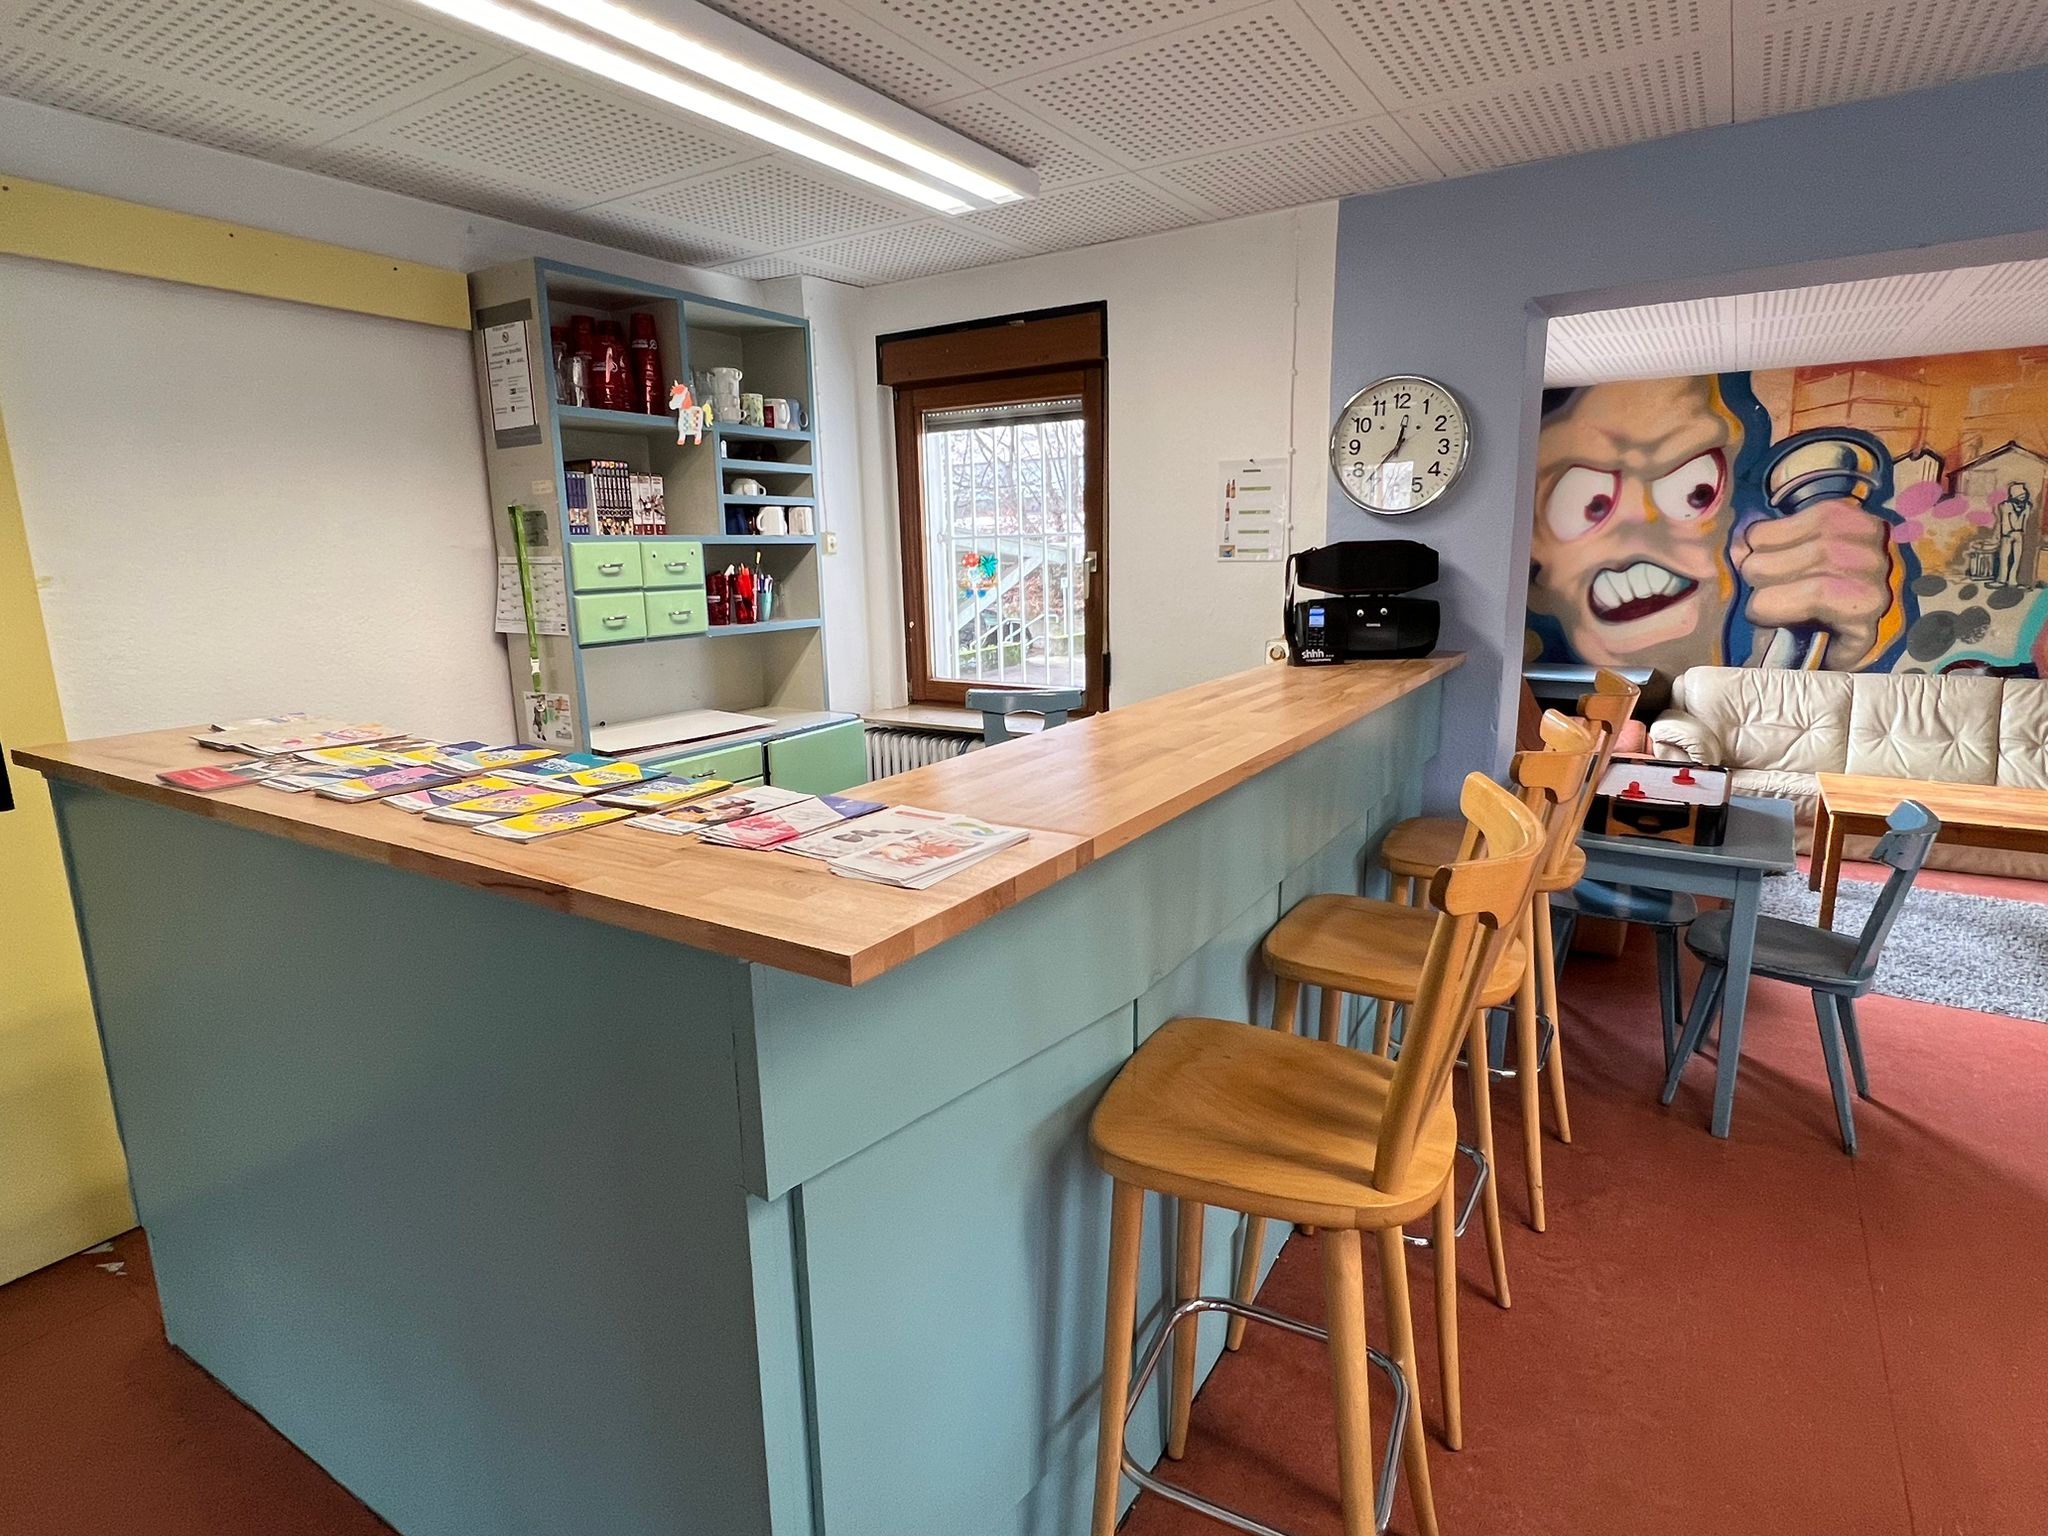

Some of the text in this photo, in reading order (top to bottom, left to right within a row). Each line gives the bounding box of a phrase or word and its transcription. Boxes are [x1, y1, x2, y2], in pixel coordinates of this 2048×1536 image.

[1373, 400, 1387, 416] 11
[1393, 393, 1412, 409] 12
[1423, 398, 1430, 414] 1
[1354, 417, 1372, 433] 10
[1434, 415, 1447, 432] 2
[1349, 439, 1361, 455] 9
[1438, 438, 1450, 455] 3
[1352, 461, 1365, 478] 8
[1427, 461, 1441, 477] 4
[1411, 477, 1423, 493] 5
[1301, 649, 1325, 659] shhh
